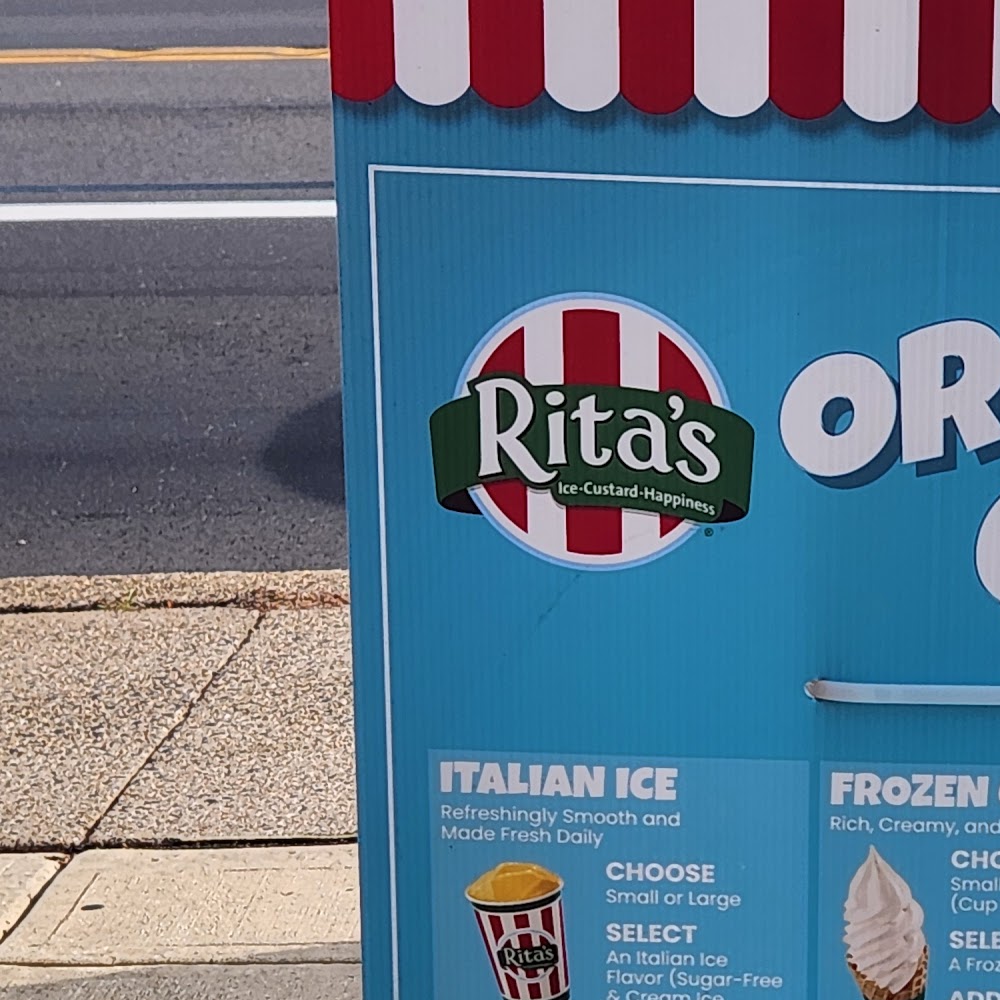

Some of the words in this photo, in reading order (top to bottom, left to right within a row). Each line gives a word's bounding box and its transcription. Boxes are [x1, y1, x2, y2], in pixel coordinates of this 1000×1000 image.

[475, 378, 720, 483] Rita's
[440, 761, 605, 797] ITALIAN
[616, 767, 678, 800] ICE
[830, 772, 989, 808] FROZEN
[441, 805, 557, 827] Refreshingly
[563, 809, 637, 825] Smooth
[642, 812, 680, 827] and
[964, 820, 1000, 834] and
[441, 827, 495, 840] Made
[501, 828, 551, 842] Fresh
[557, 830, 603, 848] Daily
[606, 862, 715, 883] CHOOSE
[606, 890, 658, 905] Small
[664, 893, 682, 905] or
[689, 892, 741, 910] Large
[951, 896, 998, 914] (Cup
[606, 924, 697, 943] SELECT
[503, 945, 554, 965] Rita's
[607, 951, 630, 965] An
[637, 952, 694, 966] Italian
[701, 953, 728, 967] Ice
[949, 958, 961, 971] A
[607, 971, 663, 985] Flavor
